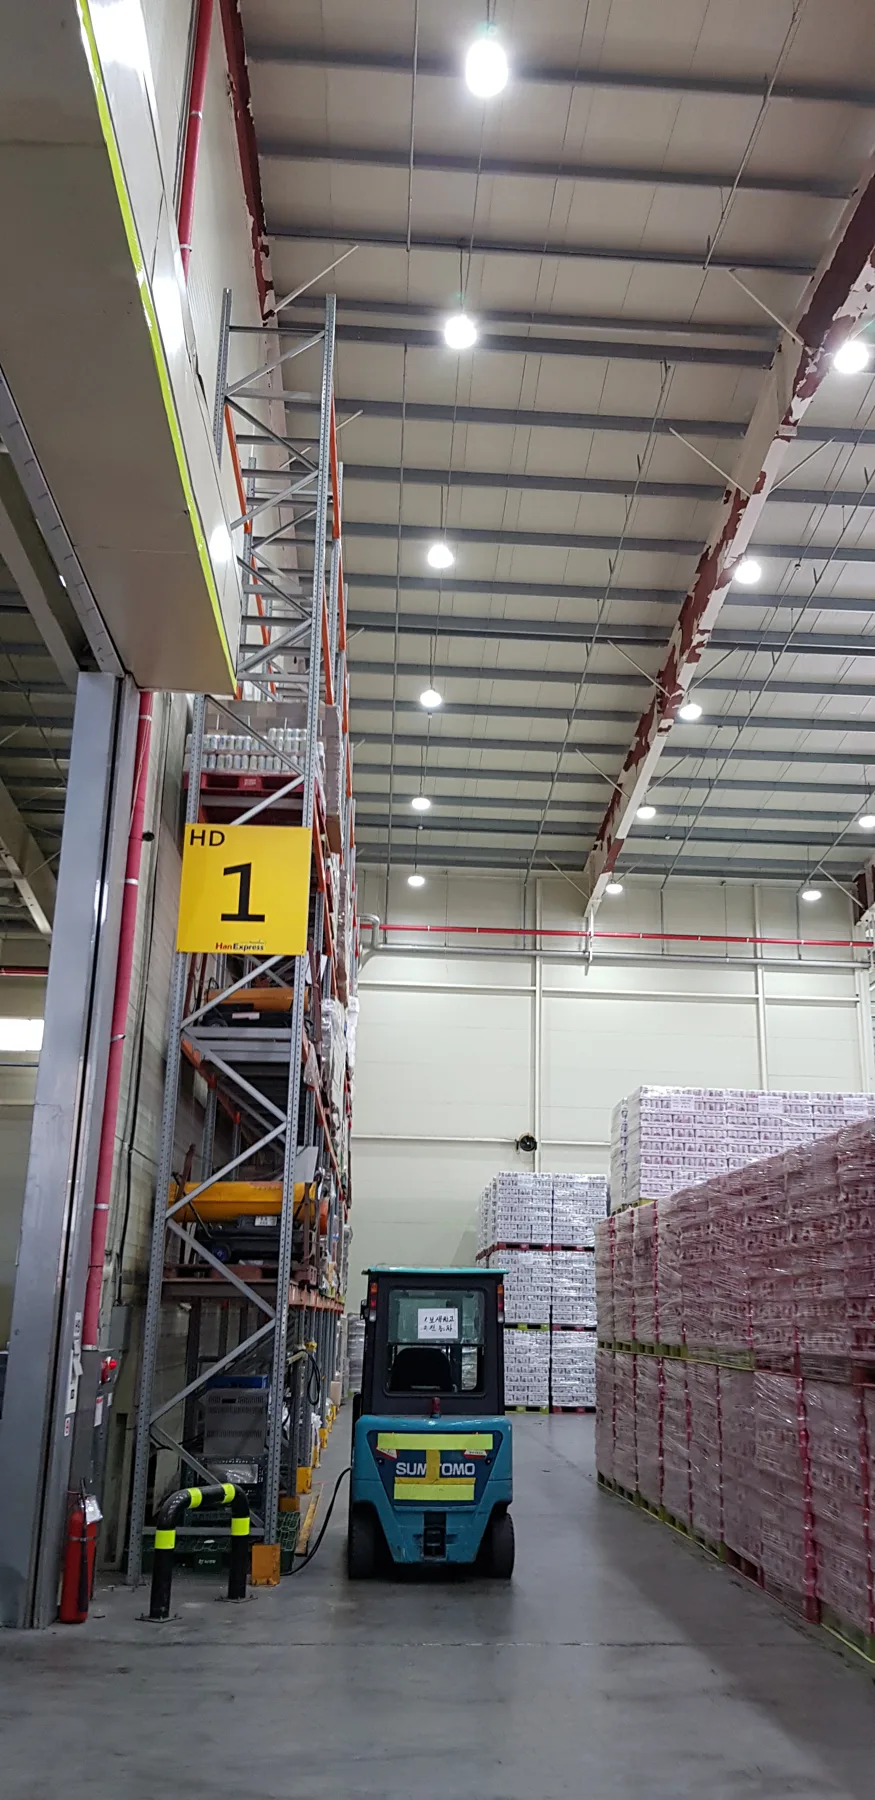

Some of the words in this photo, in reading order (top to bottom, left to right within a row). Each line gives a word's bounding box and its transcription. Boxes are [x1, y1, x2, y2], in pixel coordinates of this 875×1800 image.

[189, 829, 225, 846] HD
[221, 862, 265, 922] 1
[215, 942, 264, 952] HanExpress
[396, 1462, 475, 1476] SUMOMO
